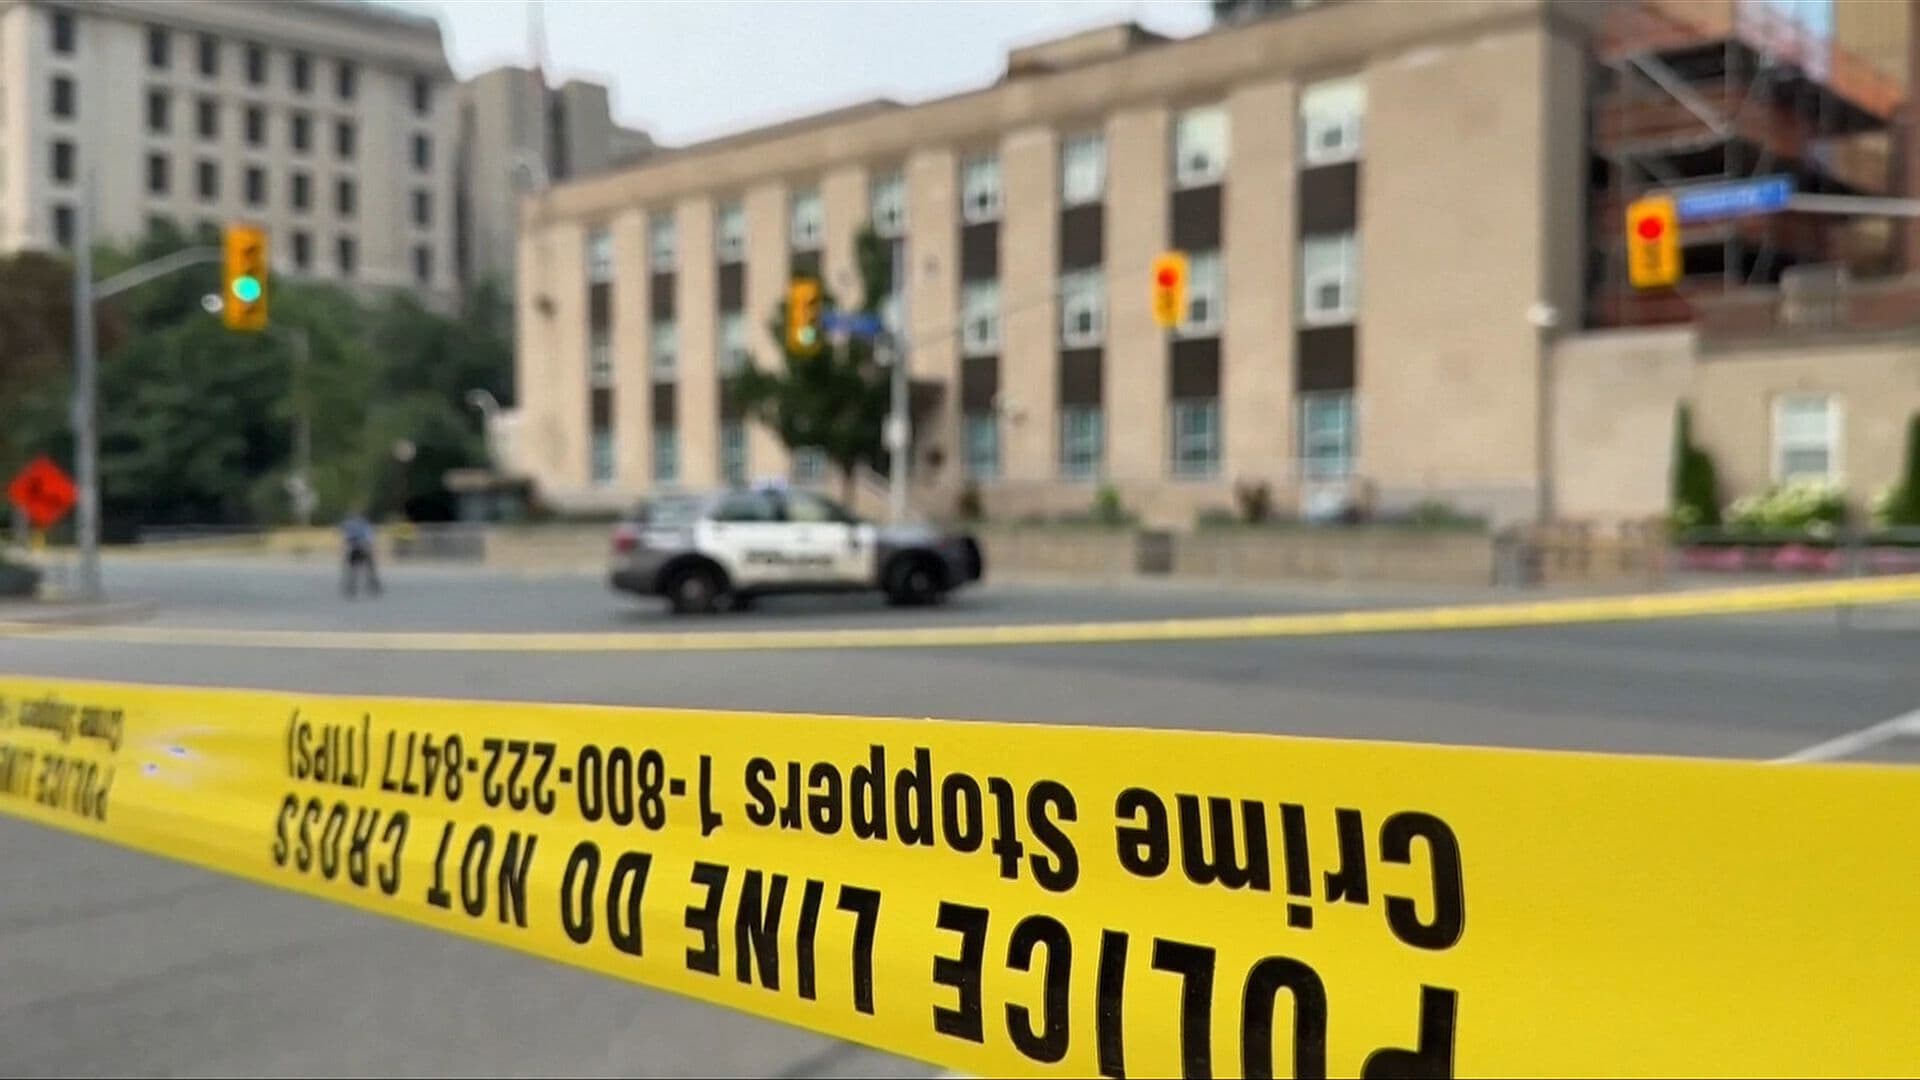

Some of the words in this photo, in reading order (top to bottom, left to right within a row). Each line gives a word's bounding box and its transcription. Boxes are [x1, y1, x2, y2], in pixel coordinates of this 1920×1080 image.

[287, 708, 370, 790] (TIPS)
[380, 733, 723, 838] 1-800-222-8477
[272, 795, 408, 897] CROSS
[745, 745, 1079, 893] Stoppers
[1115, 787, 1467, 950] Crime
[427, 822, 537, 928] NOT
[560, 841, 652, 957] DO
[684, 861, 881, 1015] LINE
